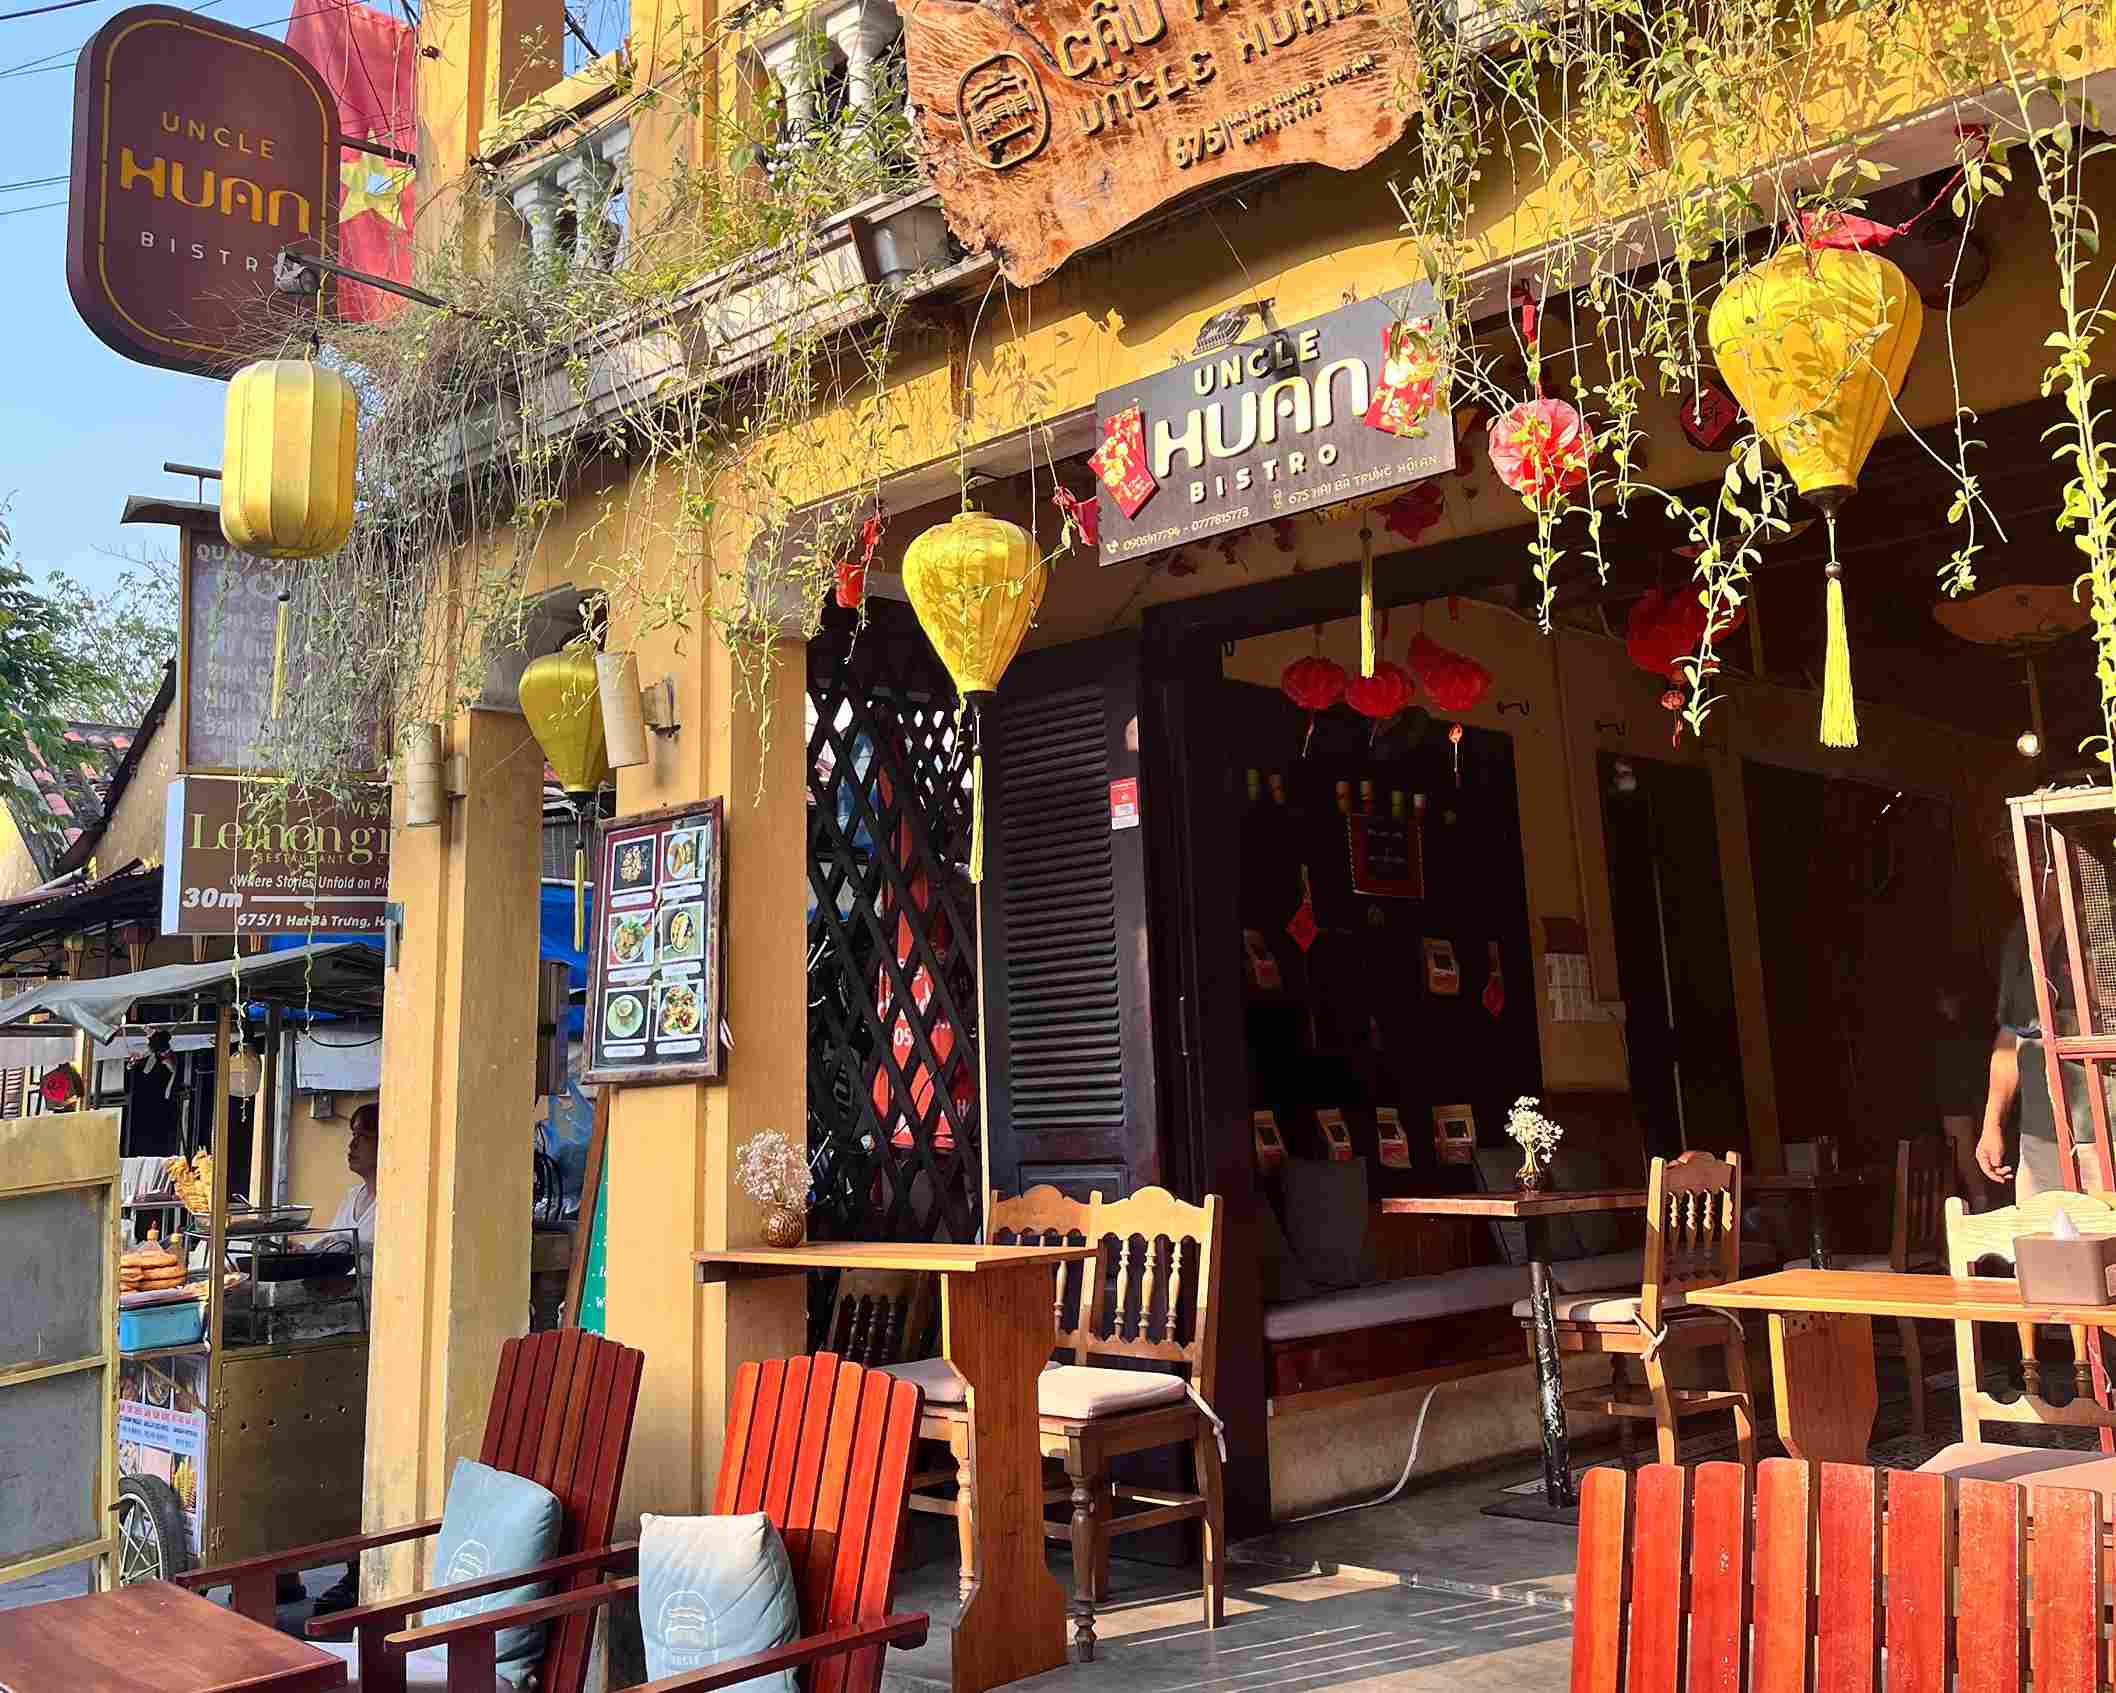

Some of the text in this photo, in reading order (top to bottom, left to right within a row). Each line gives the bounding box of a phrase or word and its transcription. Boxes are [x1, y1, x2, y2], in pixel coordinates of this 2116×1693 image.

[1076, 50, 1217, 137] UNCLE
[161, 111, 276, 160] UNCLE
[120, 145, 311, 236] HUAN
[140, 231, 260, 273] BISTR
[1193, 327, 1321, 397] UNCLE
[1153, 357, 1371, 480] HUAN
[1189, 442, 1338, 504] BISTRO
[182, 887, 244, 909] 30m
[318, 876, 354, 889] Unfold
[357, 879, 371, 889] on
[237, 912, 281, 927] 675/1
